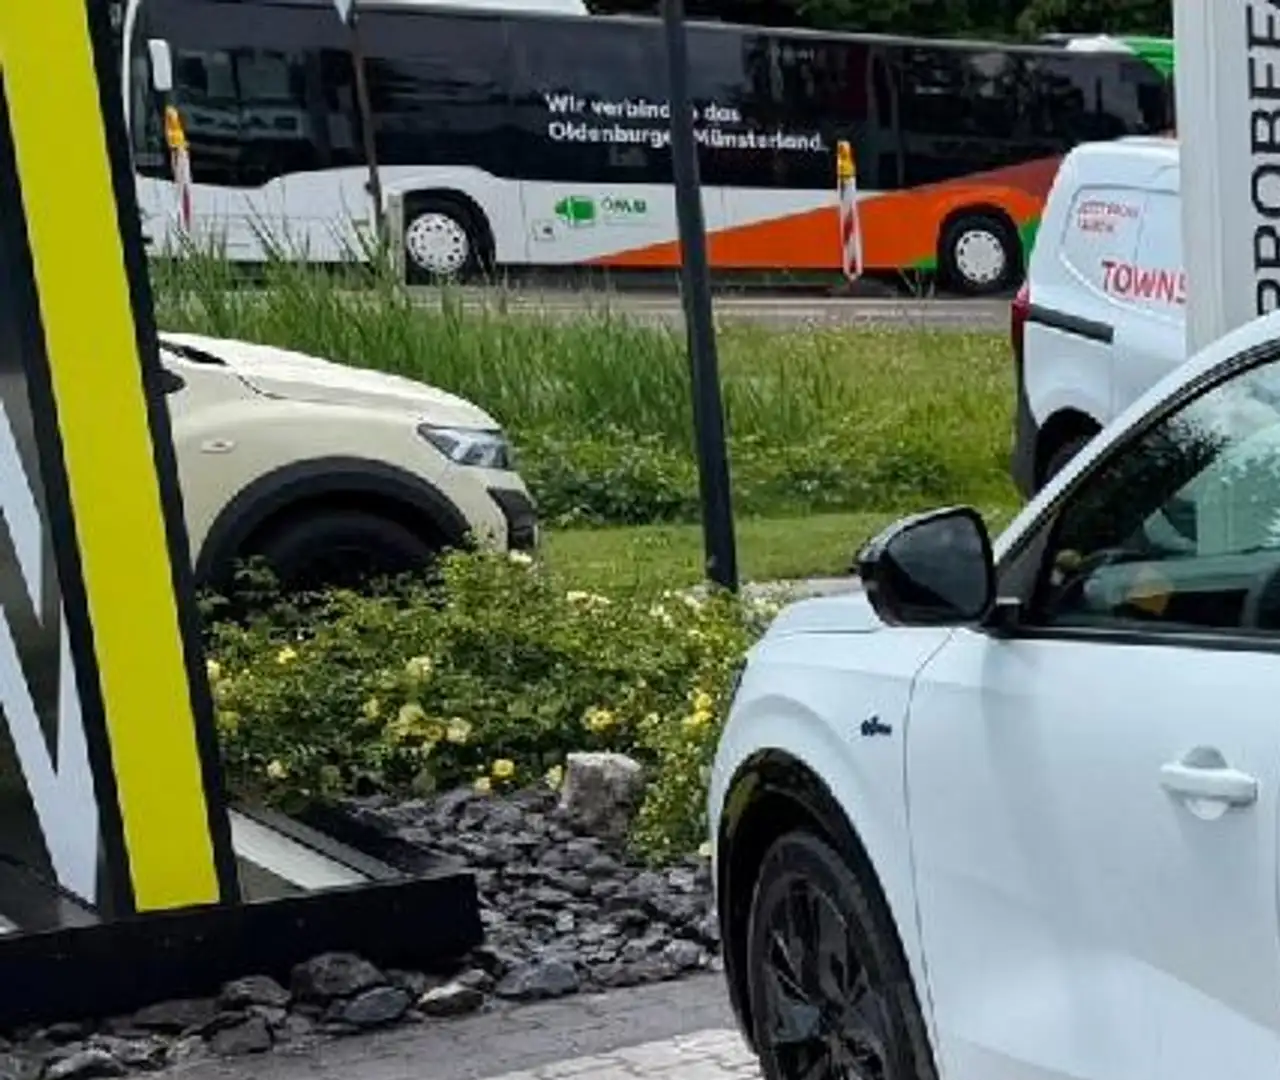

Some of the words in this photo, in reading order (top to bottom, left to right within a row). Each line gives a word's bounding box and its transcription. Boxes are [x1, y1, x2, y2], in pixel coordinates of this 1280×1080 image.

[545, 95, 585, 114] Wir
[704, 102, 741, 122] das
[549, 121, 672, 148] Oldenburge
